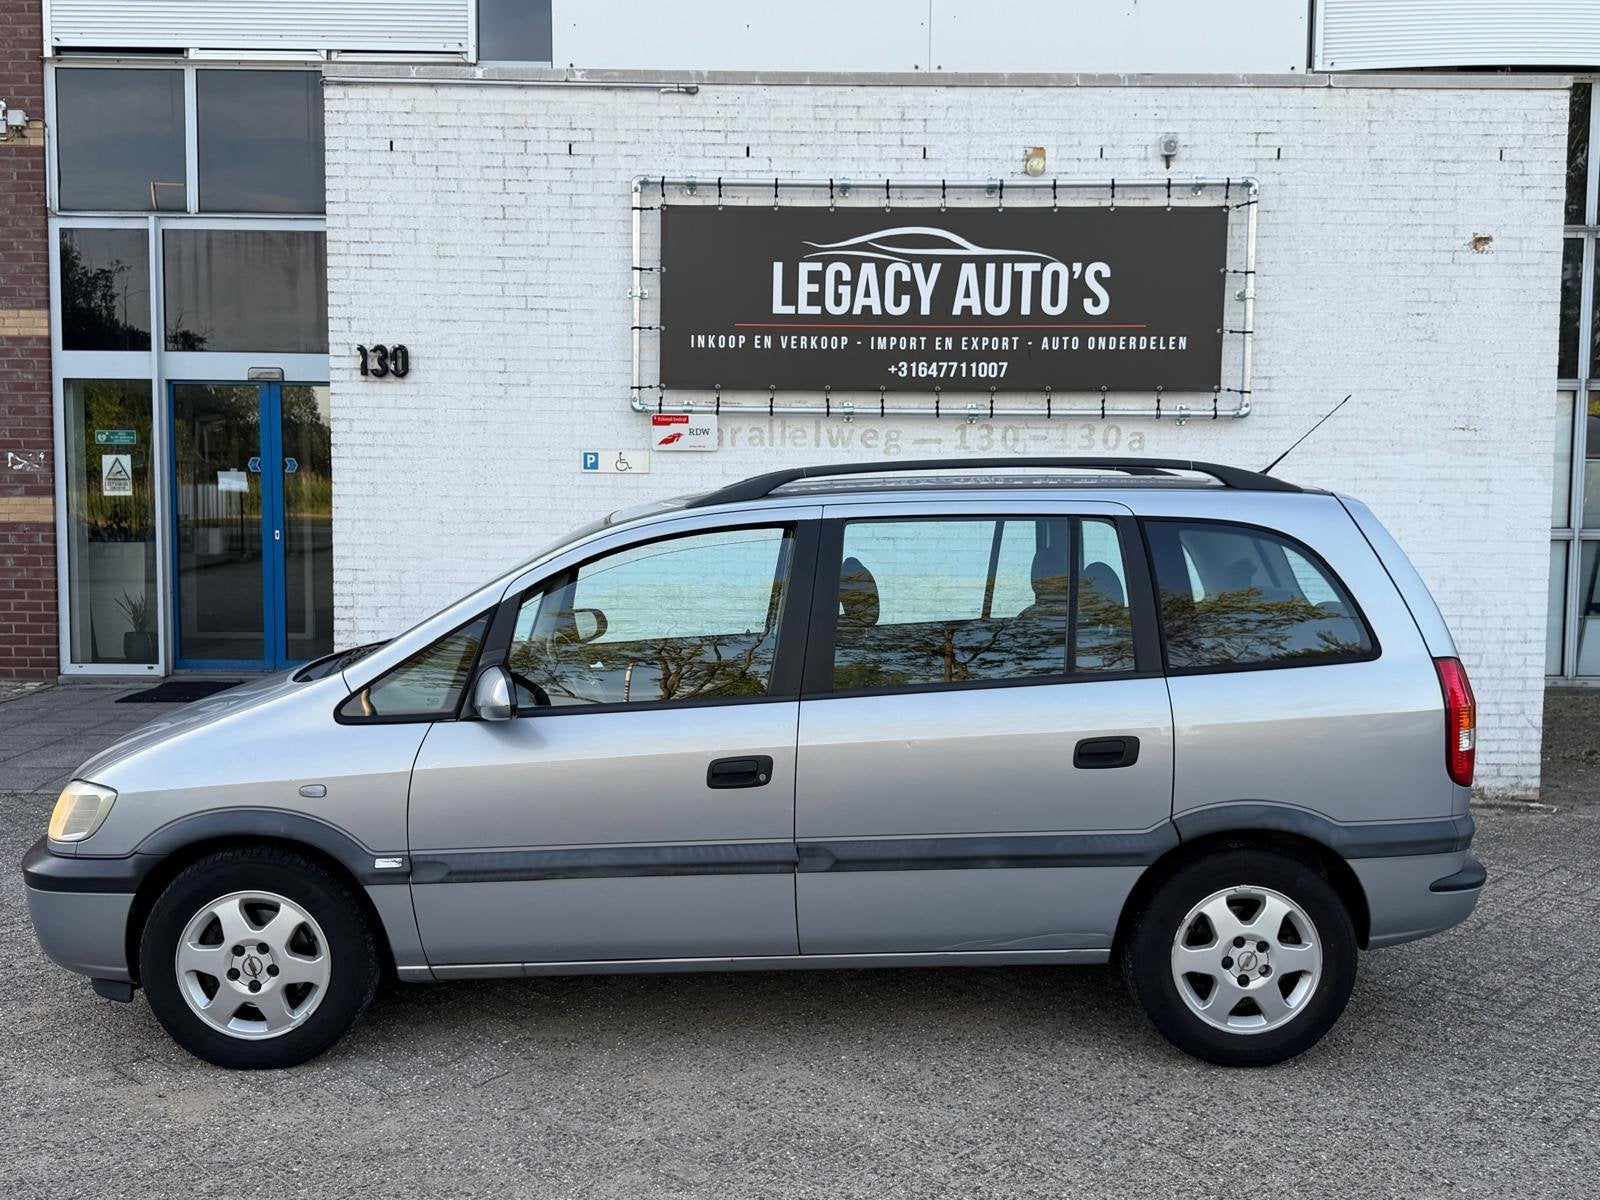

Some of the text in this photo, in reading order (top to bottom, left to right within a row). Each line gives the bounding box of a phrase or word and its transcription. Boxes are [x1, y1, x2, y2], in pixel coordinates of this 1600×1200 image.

[772, 261, 1112, 317] LEGACY AUTO'S
[690, 334, 747, 349] INKOOP
[754, 335, 772, 349] EN
[780, 336, 849, 350] VERKOOP
[870, 336, 927, 351] IMPORT
[935, 336, 954, 351] EN
[961, 336, 1019, 351] EXPORT
[1041, 336, 1079, 351] AUTO
[1087, 336, 1188, 351] ONDERDELEN
[356, 344, 409, 378] 130
[887, 361, 1009, 378] +31647711007
[688, 427, 710, 437] RDW
[586, 454, 596, 468] P
